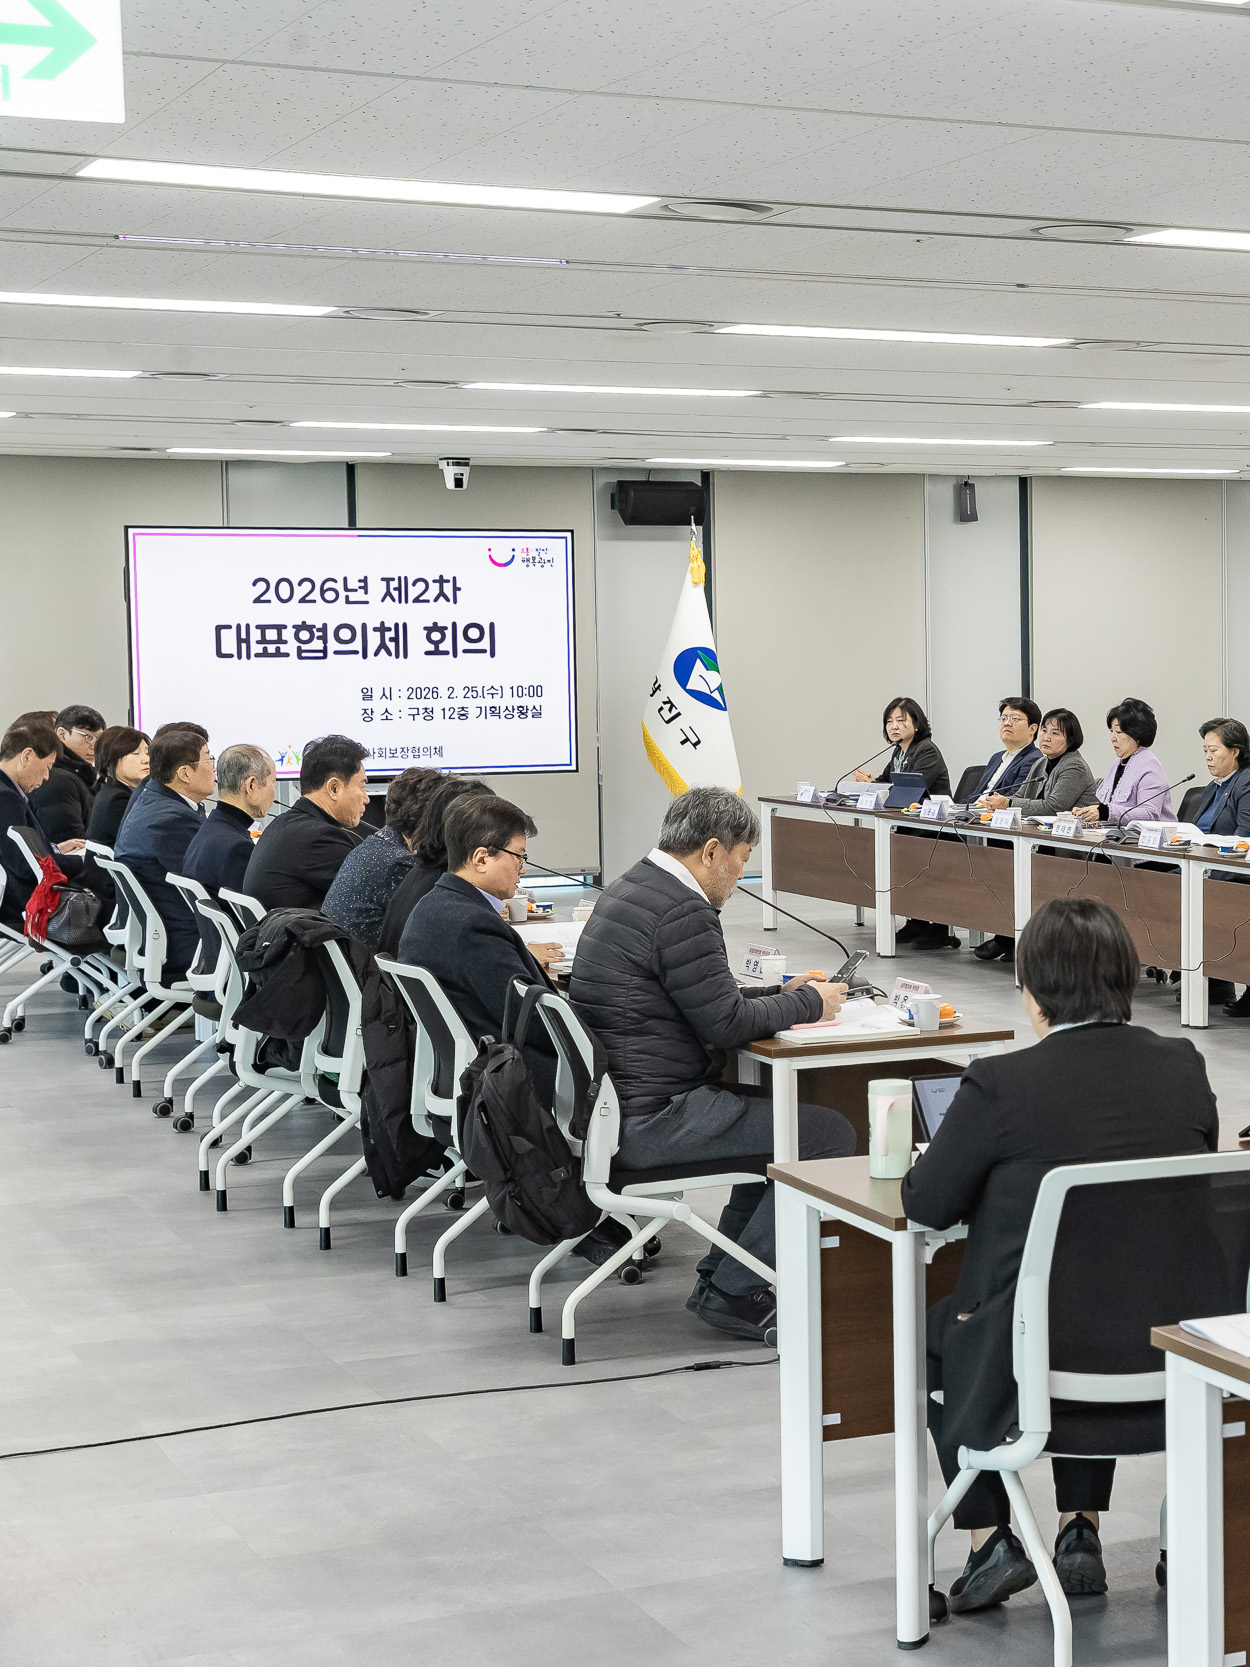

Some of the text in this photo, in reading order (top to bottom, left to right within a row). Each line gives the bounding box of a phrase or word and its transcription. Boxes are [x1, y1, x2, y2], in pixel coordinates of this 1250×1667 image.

[252, 574, 462, 605] 2026년 제2차
[214, 620, 496, 661] 대표협의체 회의
[361, 687, 374, 701] 일
[379, 687, 392, 701] 시
[406, 686, 443, 700] 2026.
[447, 686, 458, 700] 2.
[509, 684, 543, 698] 10:00
[361, 708, 374, 722] 장
[380, 708, 393, 721] 소
[407, 707, 435, 721] 구청
[441, 706, 469, 720] 12층
[475, 705, 543, 719] 기획상황실
[650, 676, 702, 750] 진구
